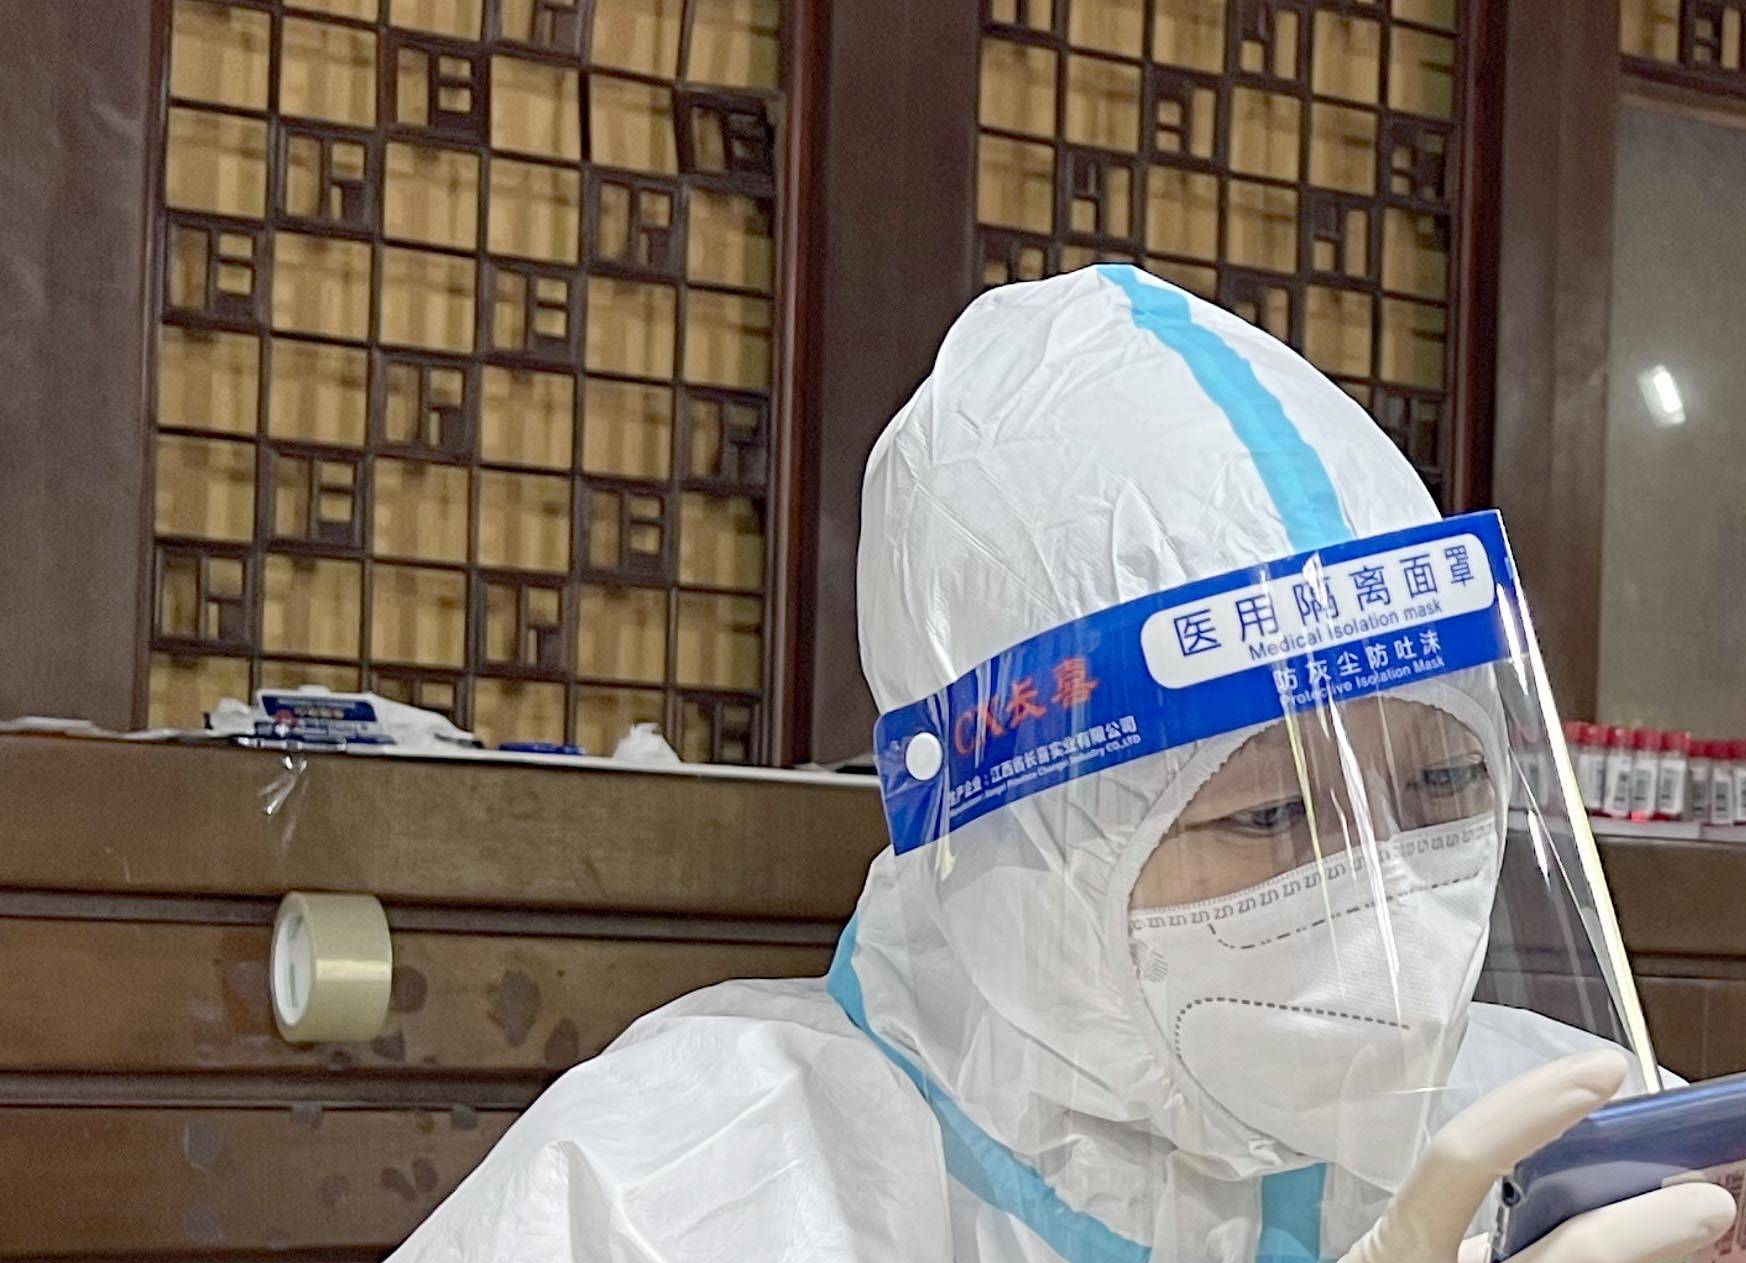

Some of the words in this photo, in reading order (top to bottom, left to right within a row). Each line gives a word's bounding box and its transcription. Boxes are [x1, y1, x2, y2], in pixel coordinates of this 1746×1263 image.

[1173, 544, 1475, 657] 医用隔离面罩
[1249, 632, 1322, 661] Medical
[1328, 610, 1399, 641] Isolation
[1403, 599, 1443, 622] mask
[1355, 664, 1412, 688] Isolation
[1413, 656, 1445, 674] Mask
